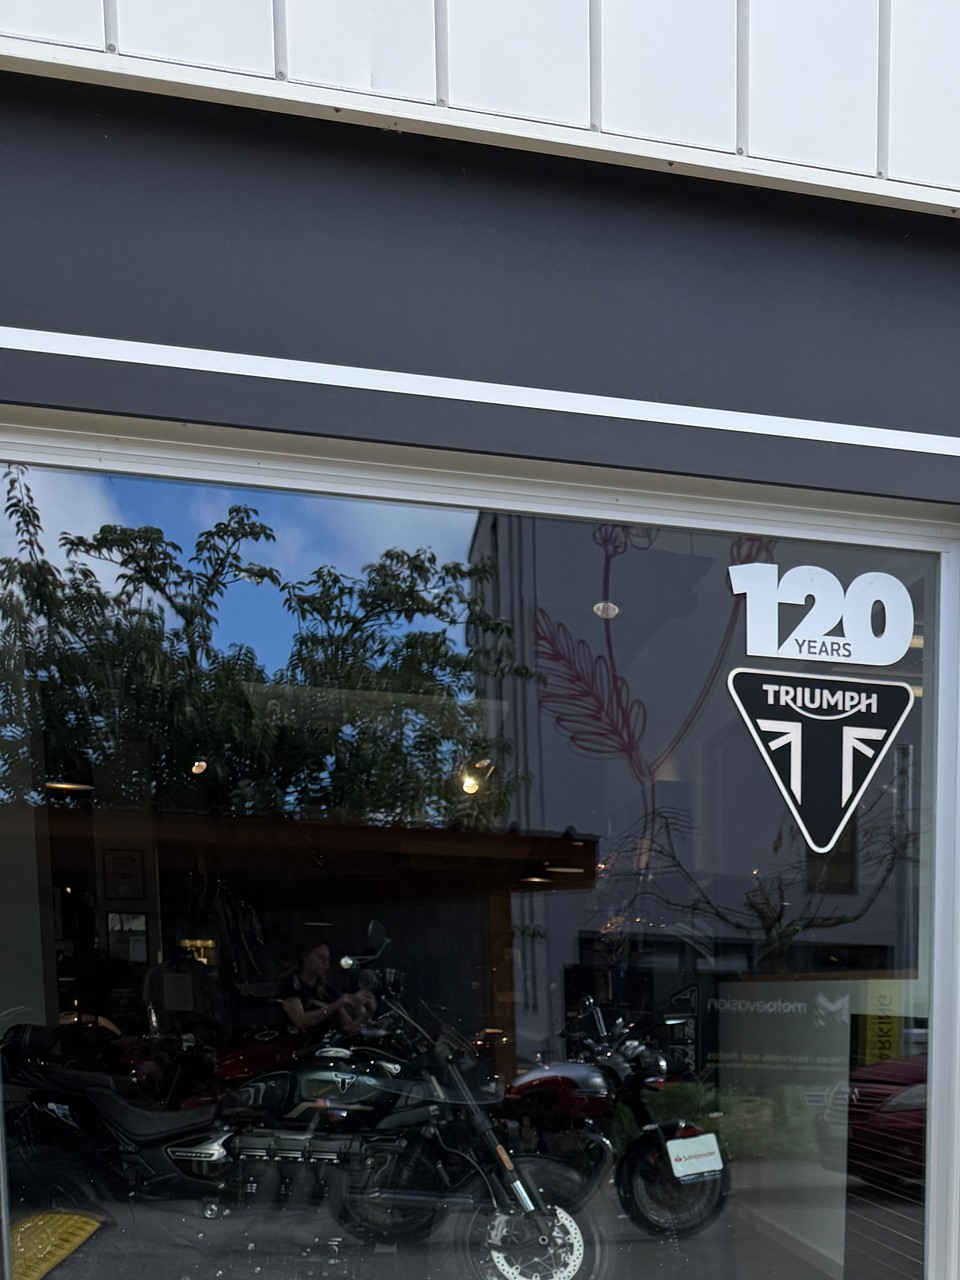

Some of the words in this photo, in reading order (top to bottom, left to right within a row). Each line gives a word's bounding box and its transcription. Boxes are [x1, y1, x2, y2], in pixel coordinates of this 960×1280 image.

[728, 562, 915, 667] 120
[795, 638, 852, 658] YEARS
[762, 684, 878, 718] TRIUMPH
